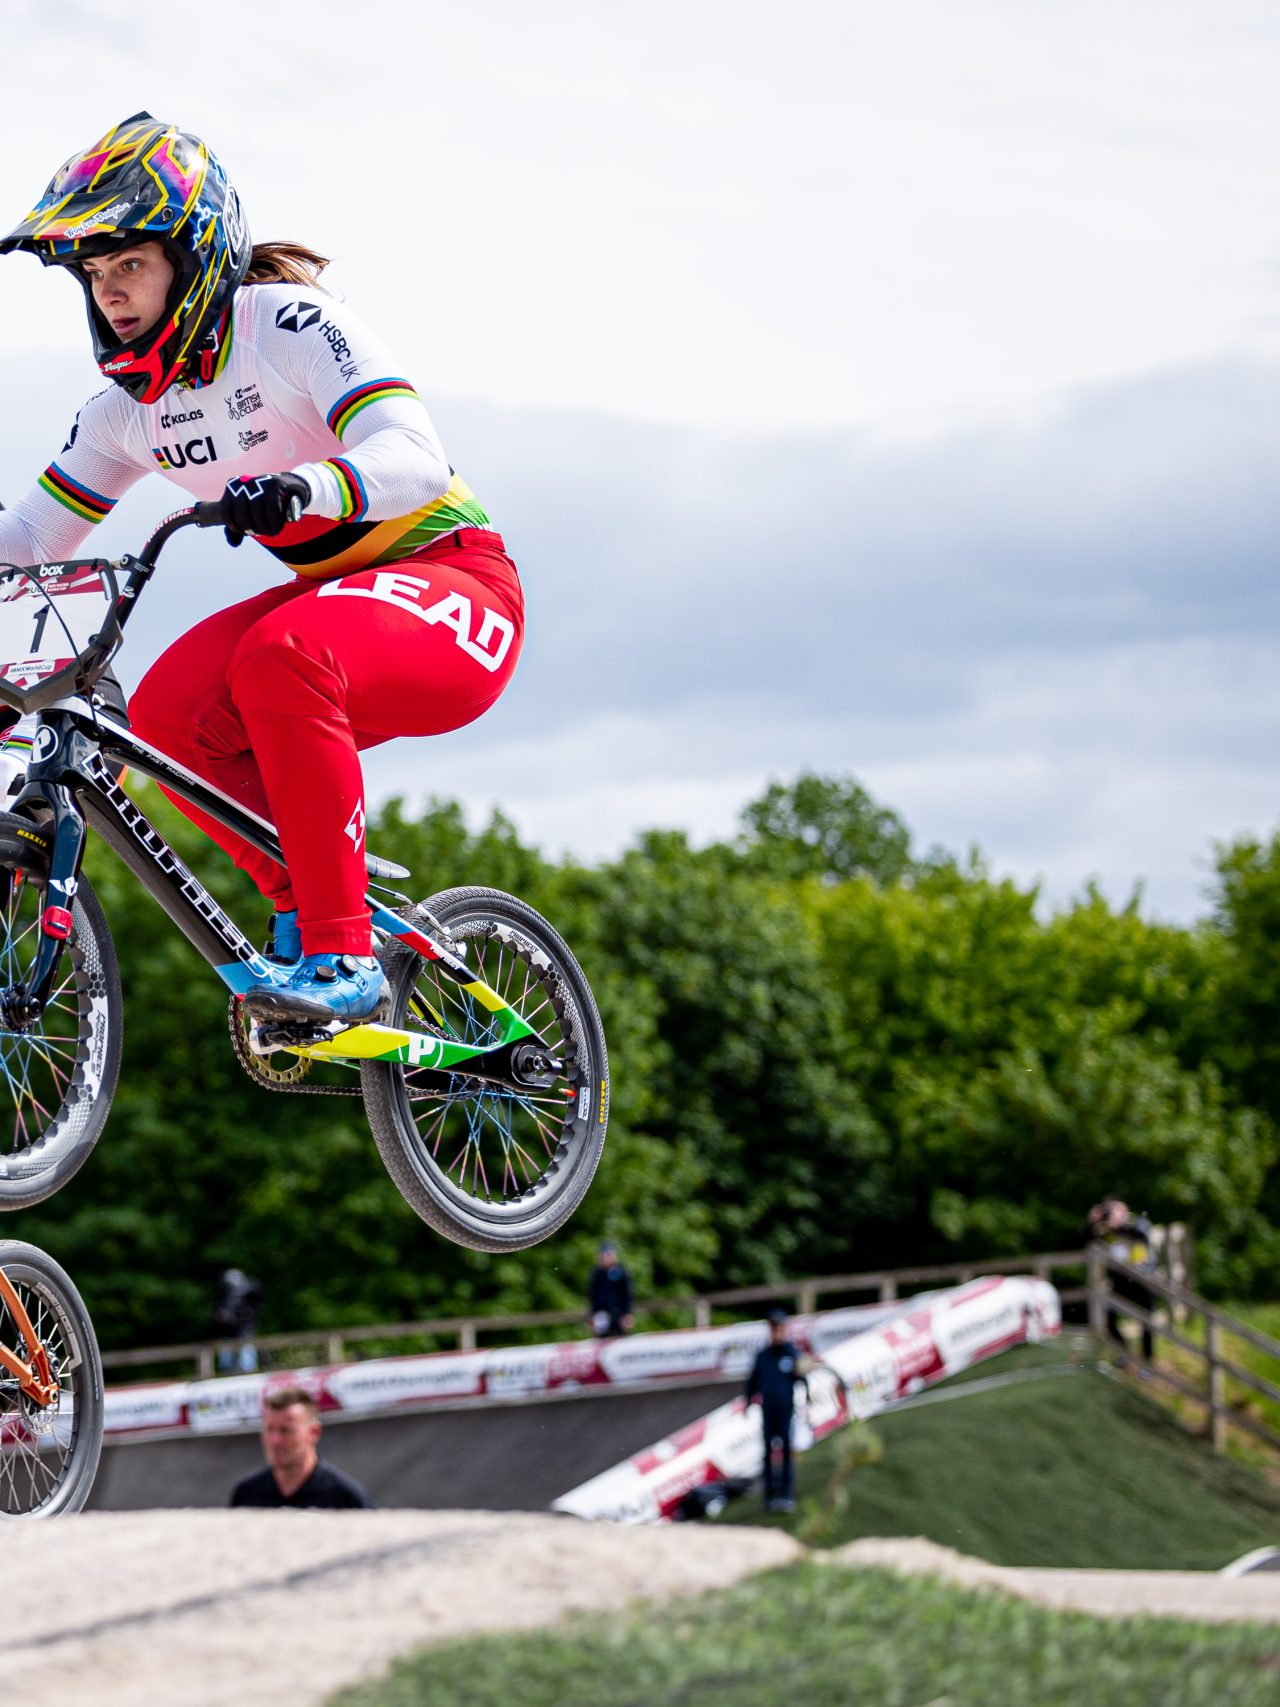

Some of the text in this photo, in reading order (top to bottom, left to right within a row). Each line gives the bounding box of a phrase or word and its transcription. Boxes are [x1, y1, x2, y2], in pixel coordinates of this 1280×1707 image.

[318, 320, 360, 383] HSBC UK
[237, 392, 261, 410] BRITISH
[162, 436, 218, 469] UCI
[39, 564, 65, 577] box
[30, 603, 51, 653] 1
[317, 573, 515, 673] LEAD
[131, 743, 196, 787] THE FAST MACHINE
[16, 829, 48, 848] MAXXIS
